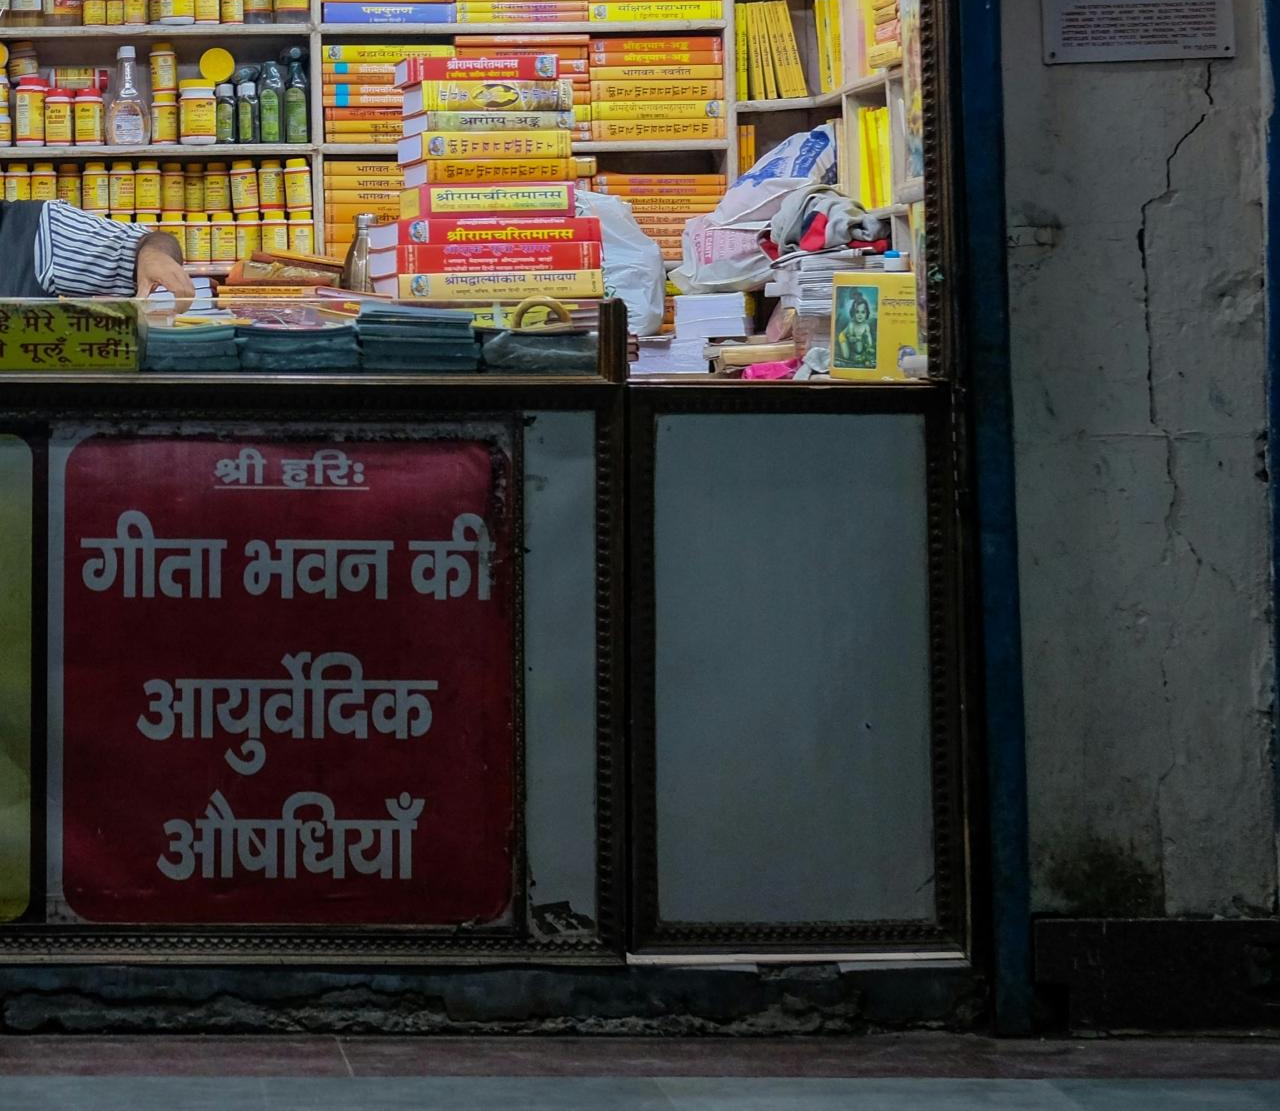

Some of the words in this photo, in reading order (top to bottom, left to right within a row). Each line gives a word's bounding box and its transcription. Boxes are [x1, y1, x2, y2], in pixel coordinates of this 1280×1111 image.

[447, 58, 519, 70] श्रीरामचरितमानस
[436, 188, 562, 201] श्रीरामचरितमानस
[447, 227, 575, 242] श्रीरामचरितमानस
[532, 272, 577, 283] रामायण
[24, 310, 56, 334] मेरे
[213, 448, 267, 486] श्री
[80, 509, 228, 600] गीता
[243, 538, 395, 600] भवन
[409, 512, 498, 601] की
[135, 651, 440, 777] आयुर्वेदिक
[155, 788, 427, 881] औषधियाँ
